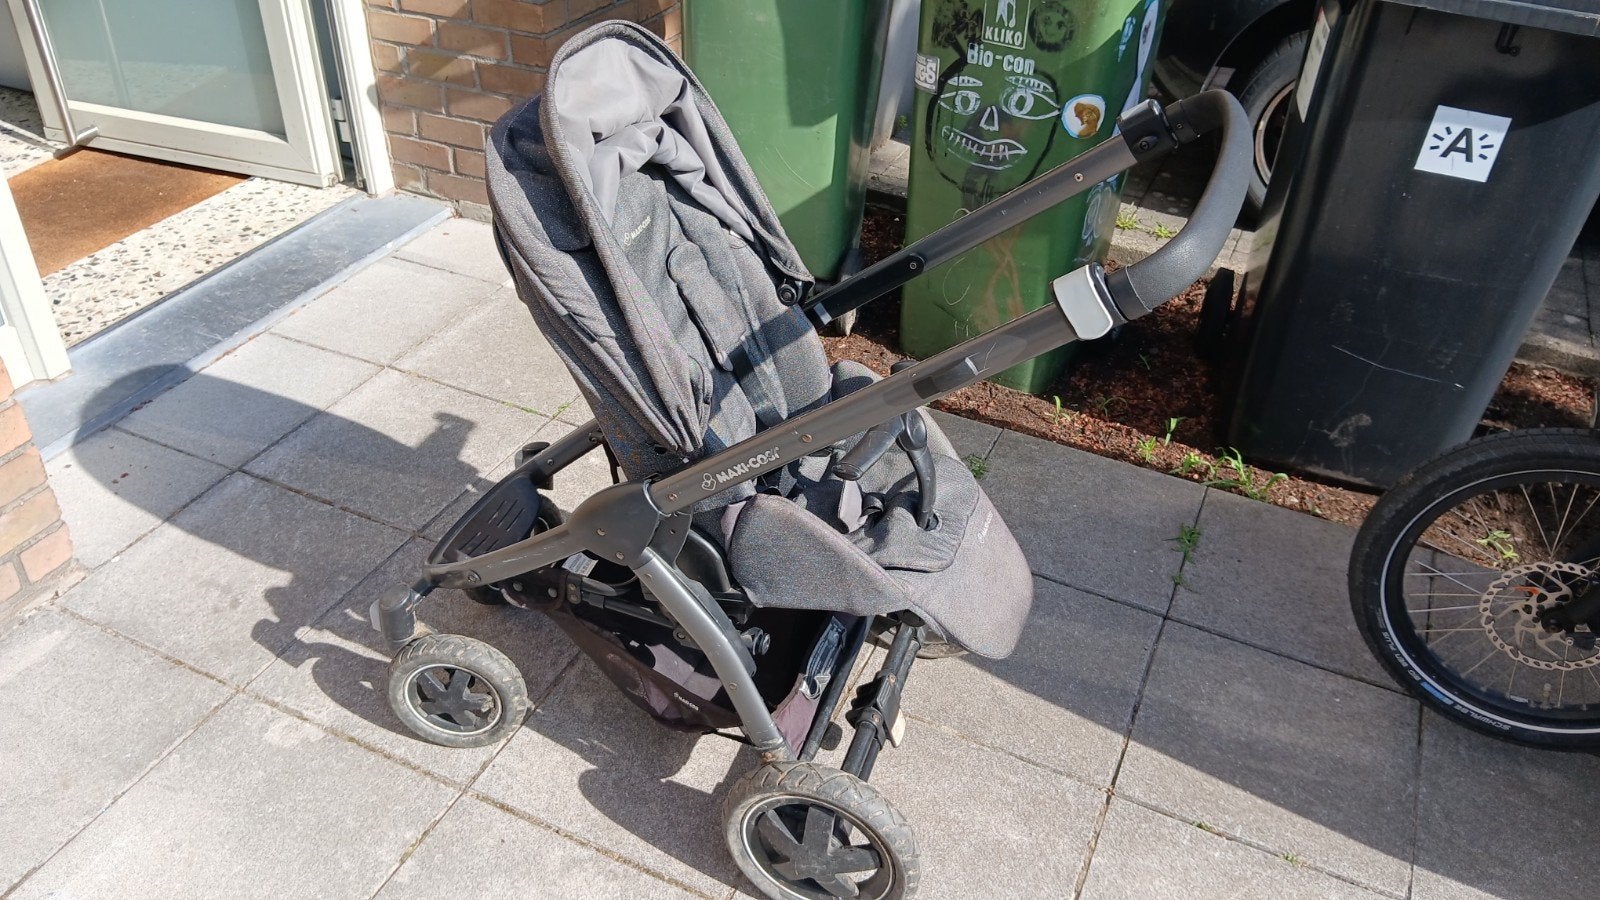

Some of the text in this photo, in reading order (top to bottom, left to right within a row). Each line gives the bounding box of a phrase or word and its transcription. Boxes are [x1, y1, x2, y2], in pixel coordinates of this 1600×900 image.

[985, 26, 1023, 46] KLIKO
[967, 42, 1036, 76] Bio-con
[1439, 127, 1474, 163] A
[1453, 704, 1512, 731] SCHWALBE
